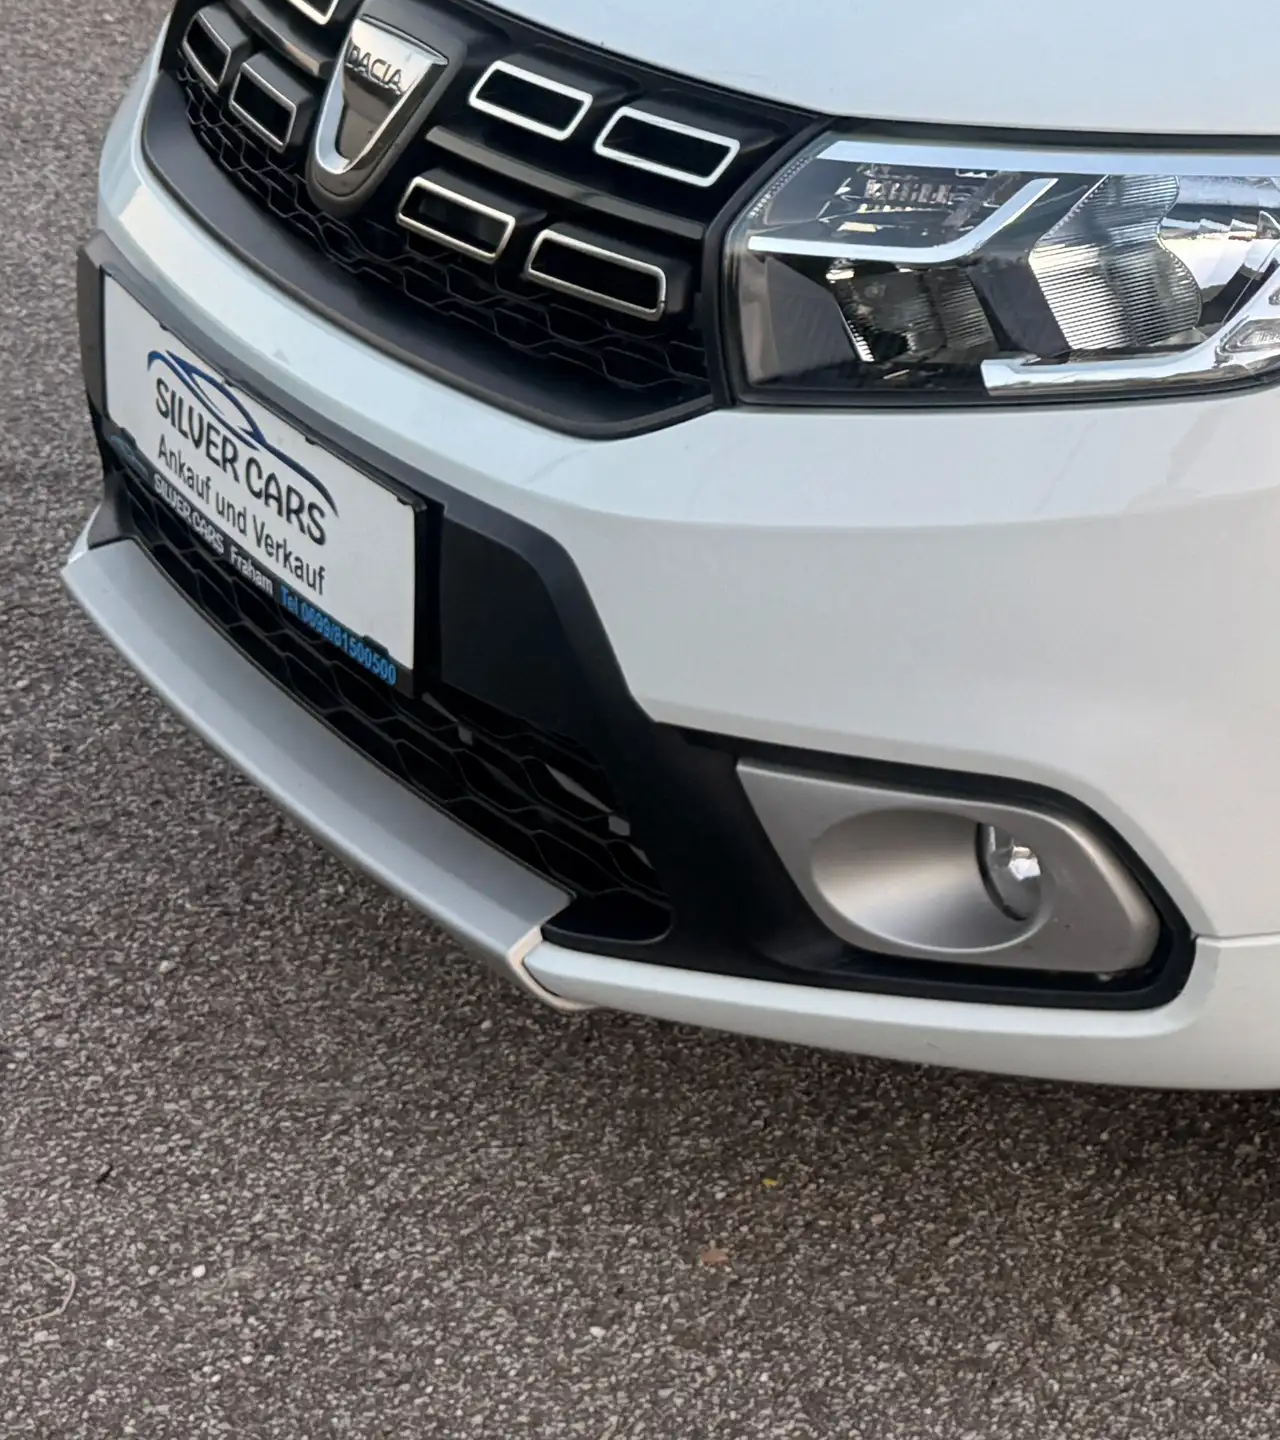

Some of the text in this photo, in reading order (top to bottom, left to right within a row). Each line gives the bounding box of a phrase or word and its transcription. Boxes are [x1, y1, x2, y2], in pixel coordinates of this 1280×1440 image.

[346, 45, 402, 92] DACIA
[156, 377, 326, 545] SILVER CARS
[158, 434, 325, 595] Ankauf und Verkauf
